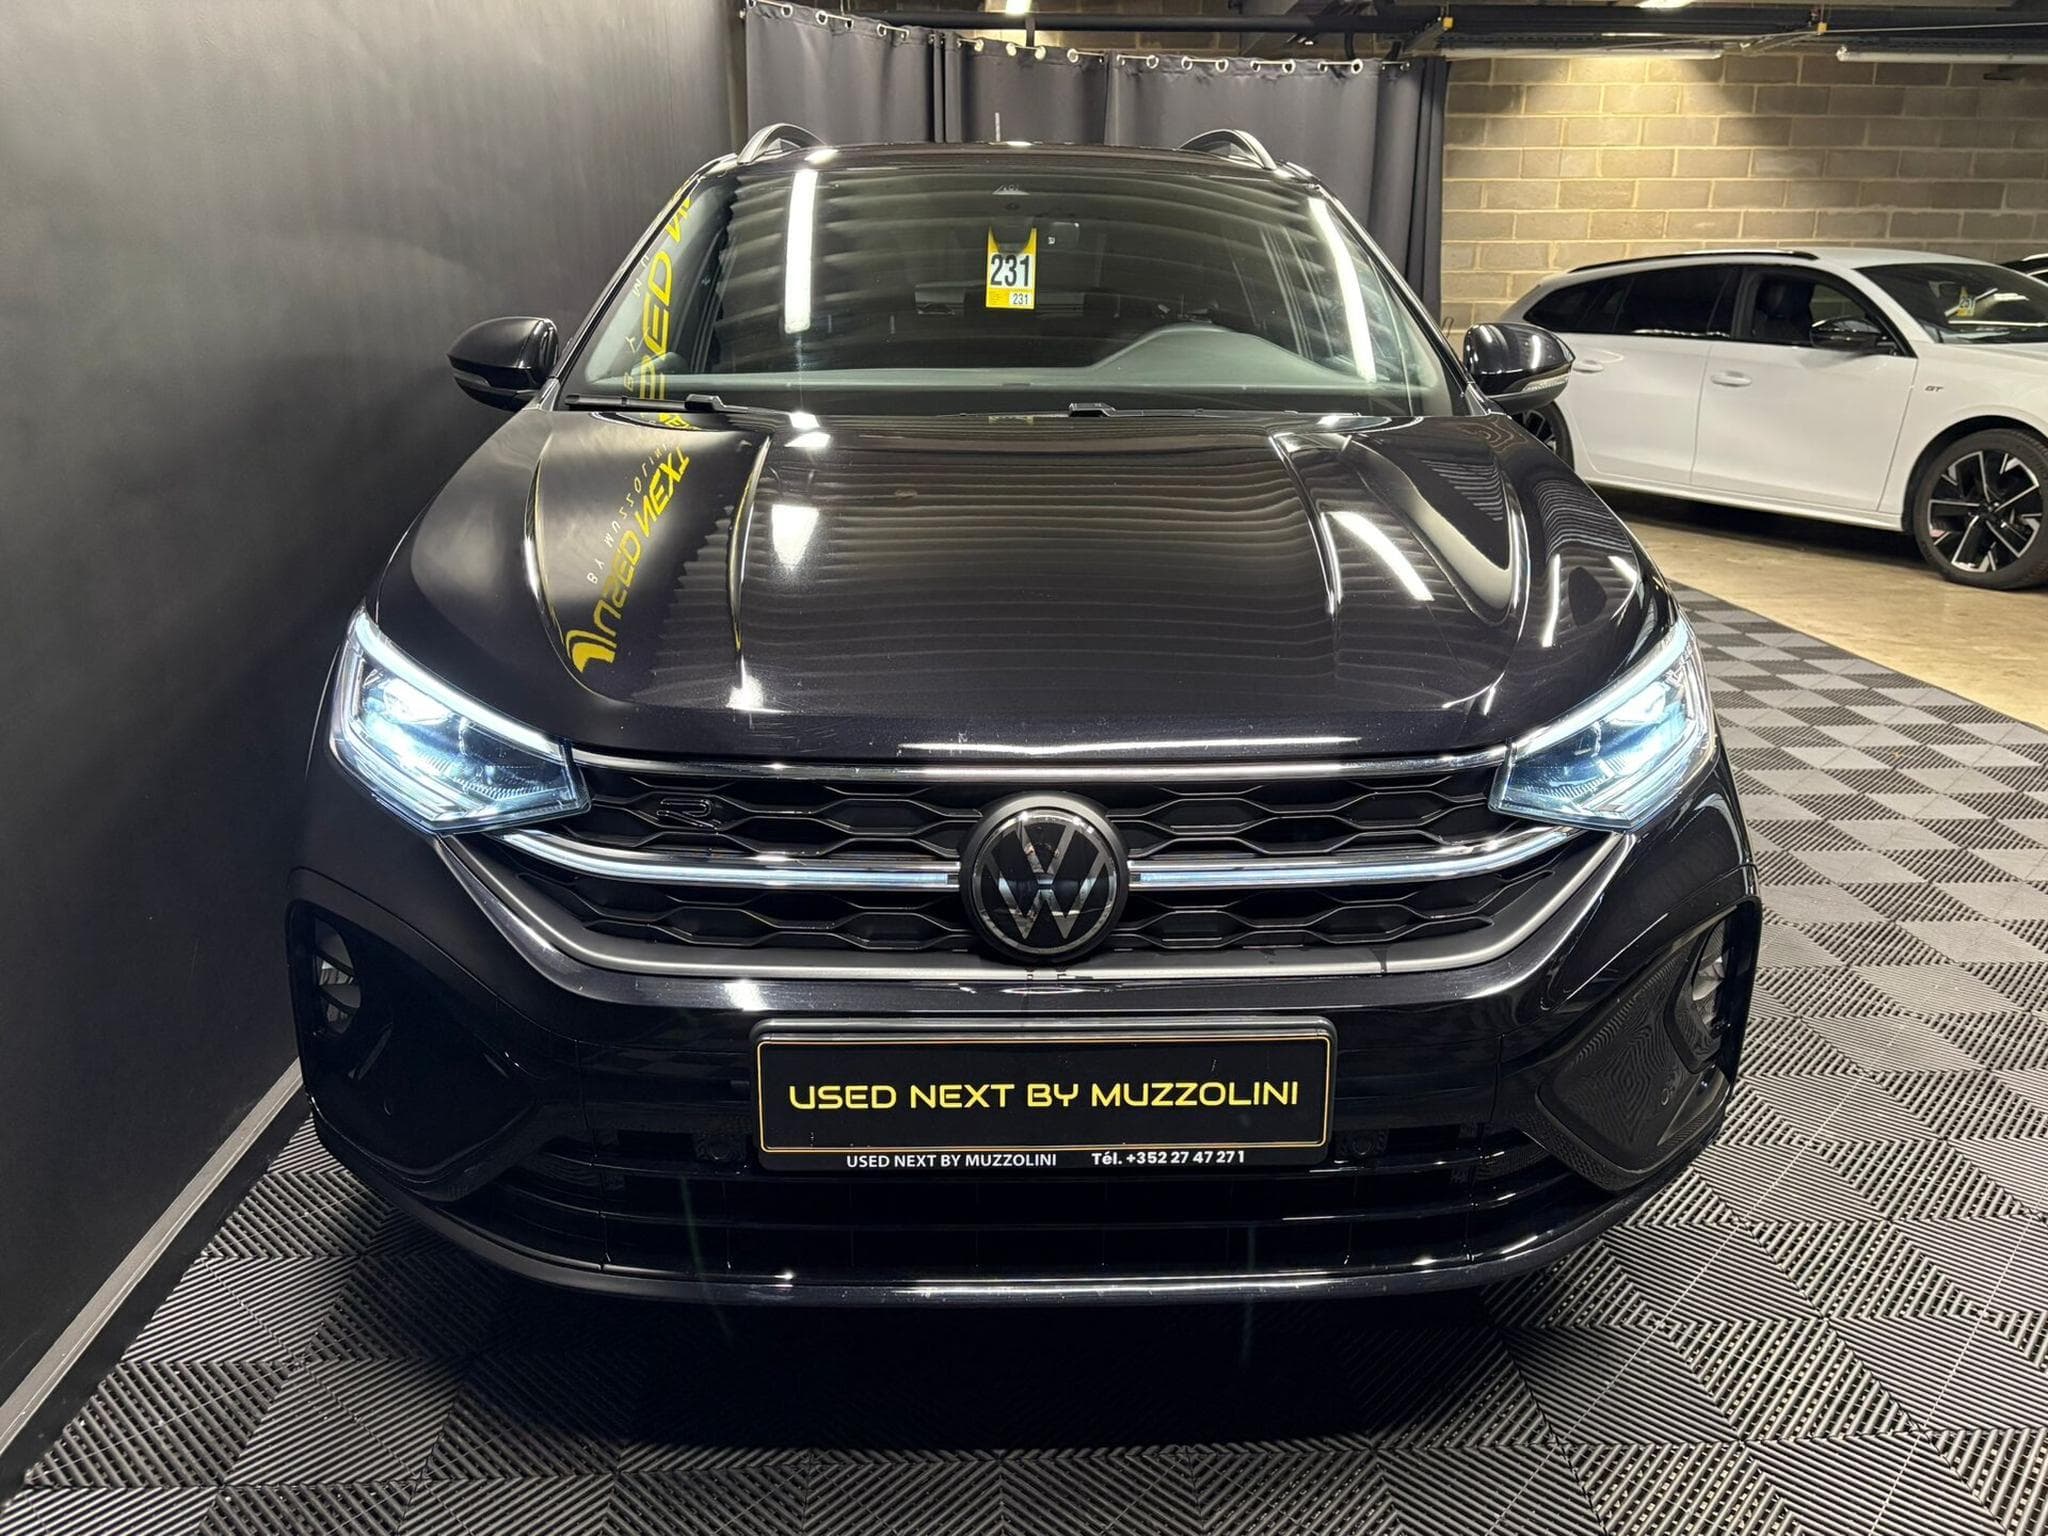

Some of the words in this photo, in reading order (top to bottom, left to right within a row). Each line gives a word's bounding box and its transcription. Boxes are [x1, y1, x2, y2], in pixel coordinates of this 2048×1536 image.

[990, 253, 1029, 287] 231
[1012, 292, 1029, 305] 231
[789, 1085, 897, 1110] USED
[910, 1083, 1014, 1109] NEXT
[1027, 1083, 1079, 1108] BY
[1091, 1081, 1299, 1107] MUZZOLINI
[846, 1155, 890, 1168] USED
[894, 1154, 937, 1168] NEXT
[940, 1154, 961, 1167] BY
[965, 1153, 1057, 1167] MUZZOLINI
[1091, 1151, 1123, 1166] Tél.
[1126, 1150, 1167, 1165] +352
[1170, 1150, 1190, 1164] 27
[1192, 1150, 1214, 1164] 47
